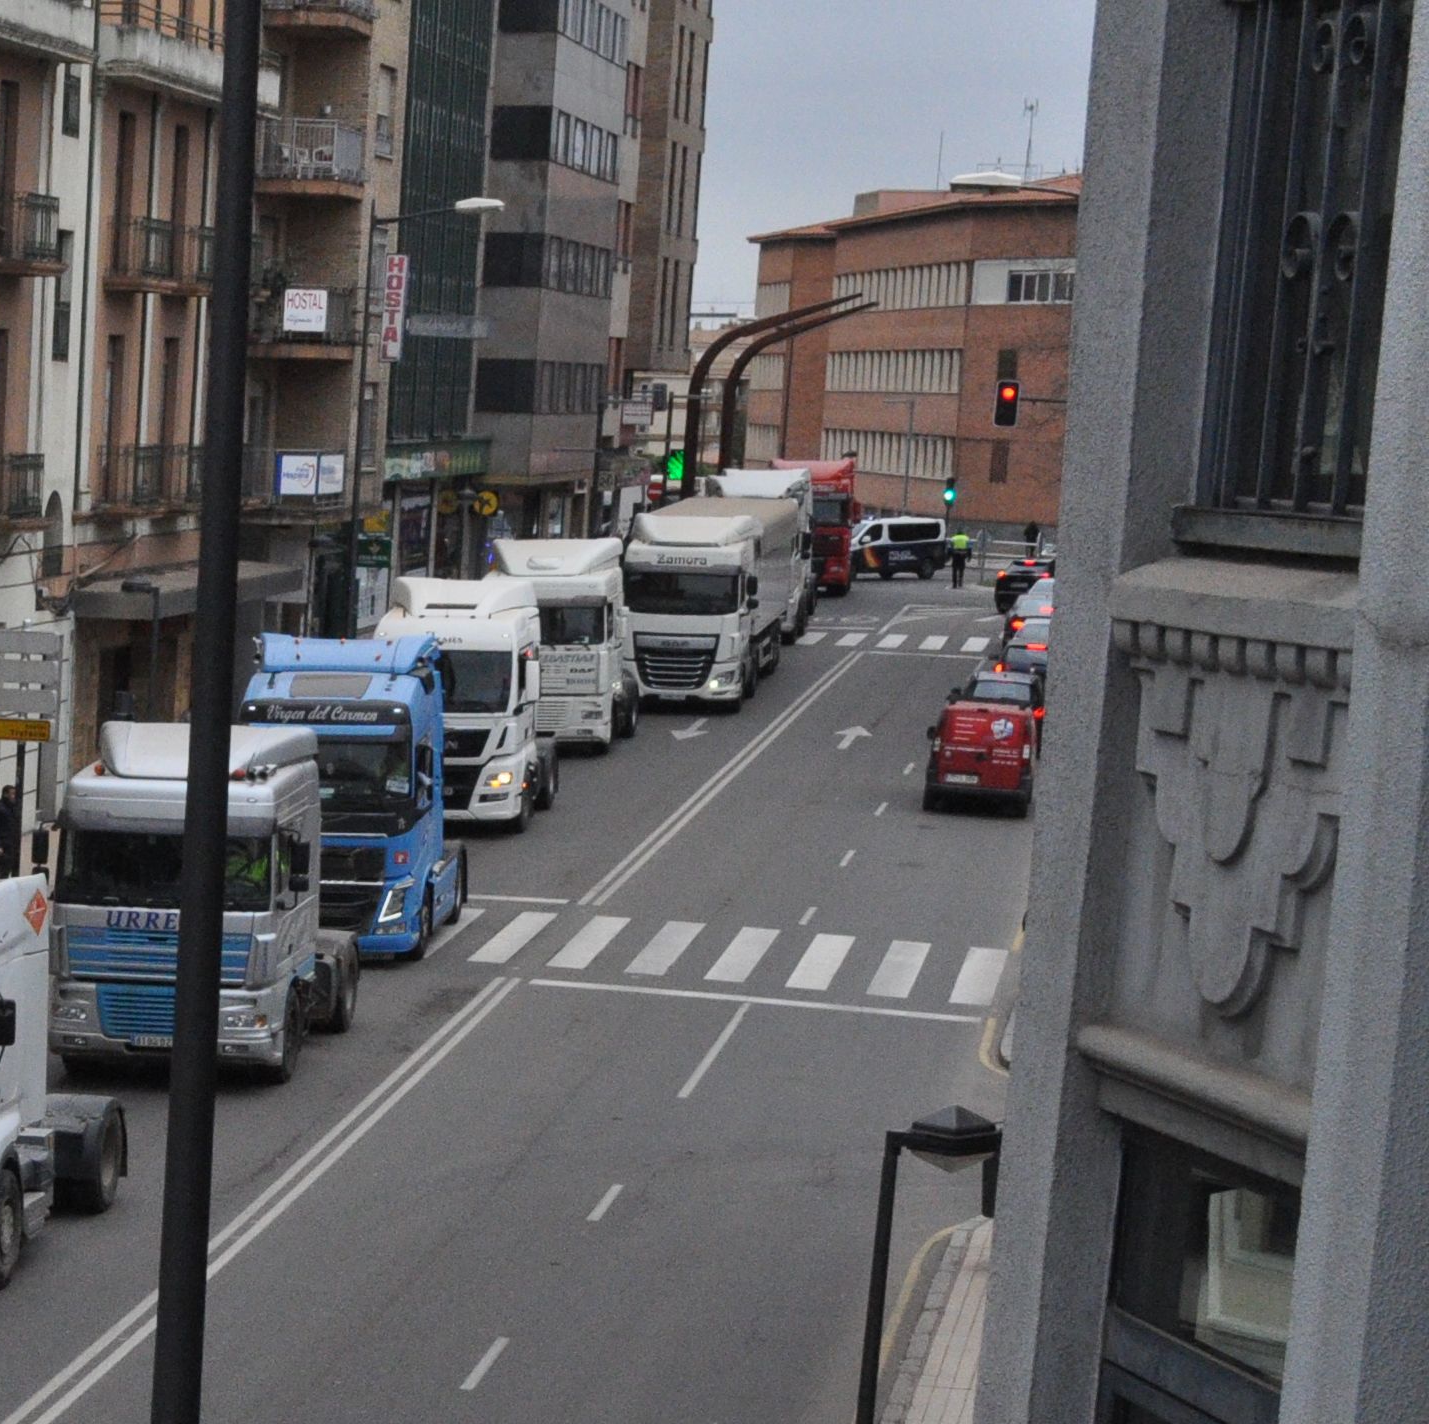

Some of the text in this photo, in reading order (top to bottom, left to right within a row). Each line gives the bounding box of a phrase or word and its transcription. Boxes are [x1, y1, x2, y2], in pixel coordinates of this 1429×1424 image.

[287, 293, 323, 310] HOSTAL
[382, 257, 406, 360] HOSTAL
[657, 554, 707, 566] Zamora
[267, 705, 378, 723] Virgen del Carmen
